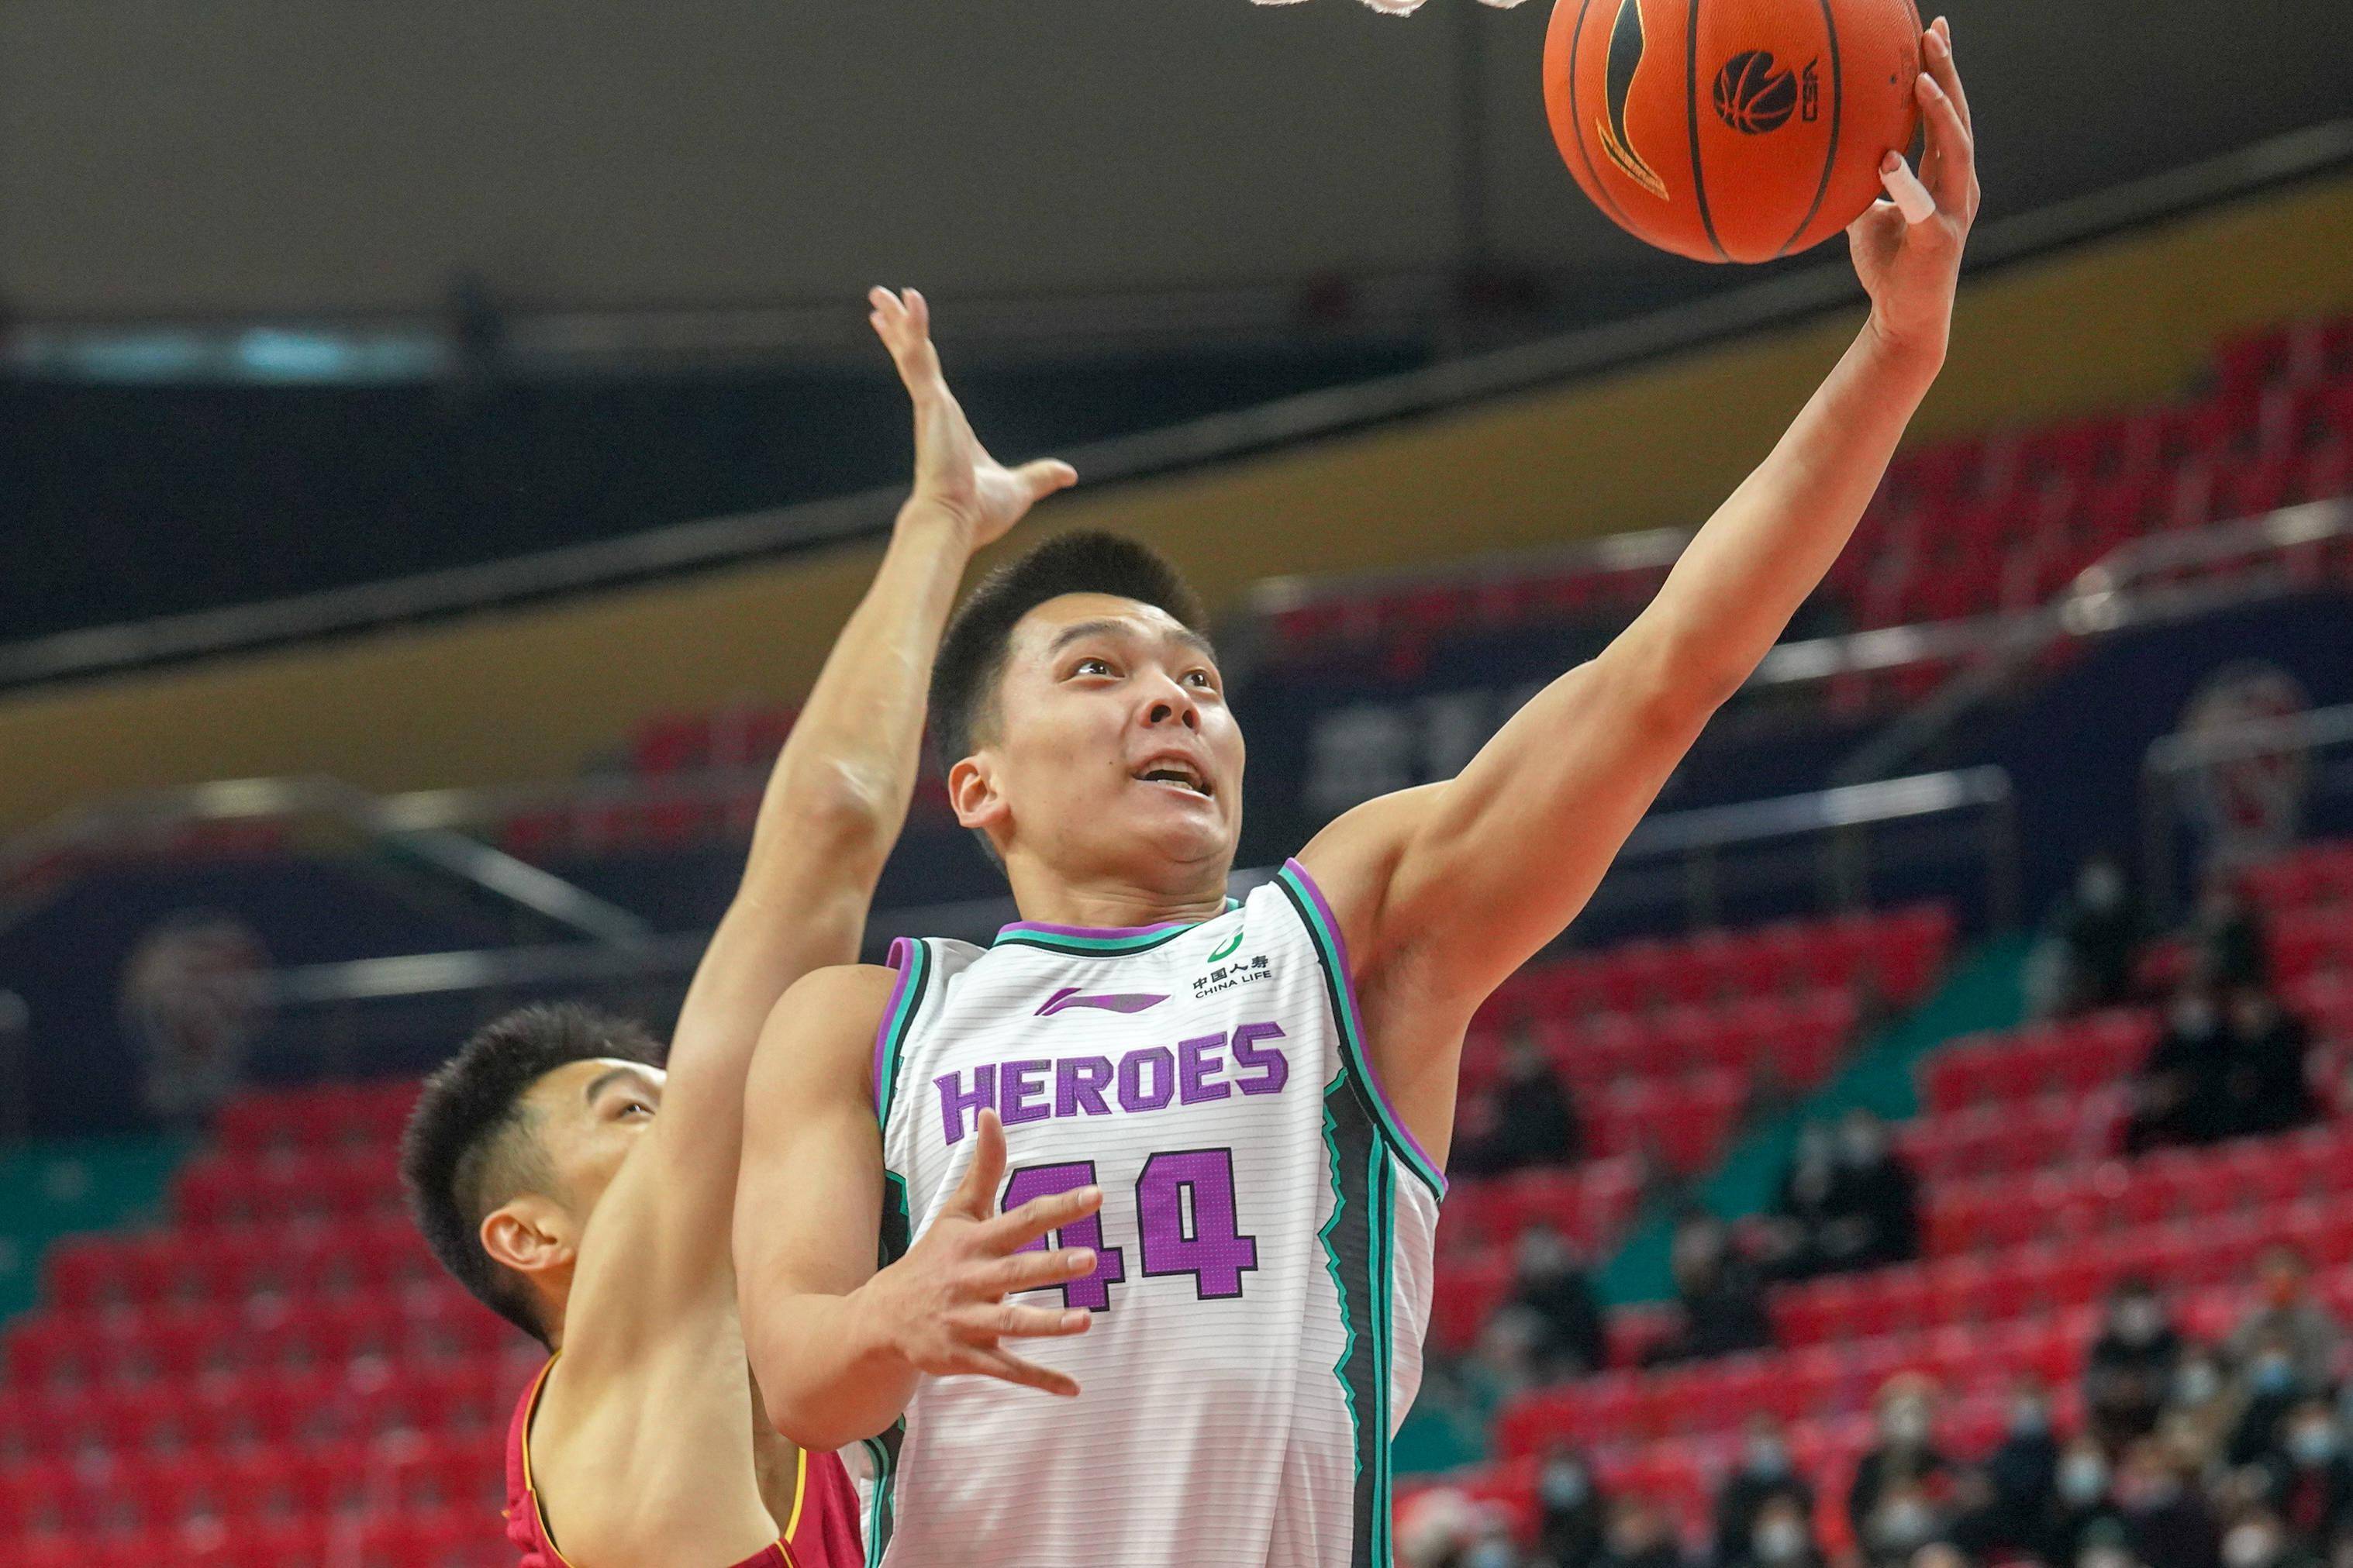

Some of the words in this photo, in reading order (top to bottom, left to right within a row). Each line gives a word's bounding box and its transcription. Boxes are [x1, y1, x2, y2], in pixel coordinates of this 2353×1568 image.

[1192, 955, 1269, 990] 中国人寿
[1195, 979, 1238, 999] CHINA
[1241, 970, 1272, 983] LIFE
[933, 1021, 1289, 1146] HEROES
[1000, 1147, 1258, 1312] 44
